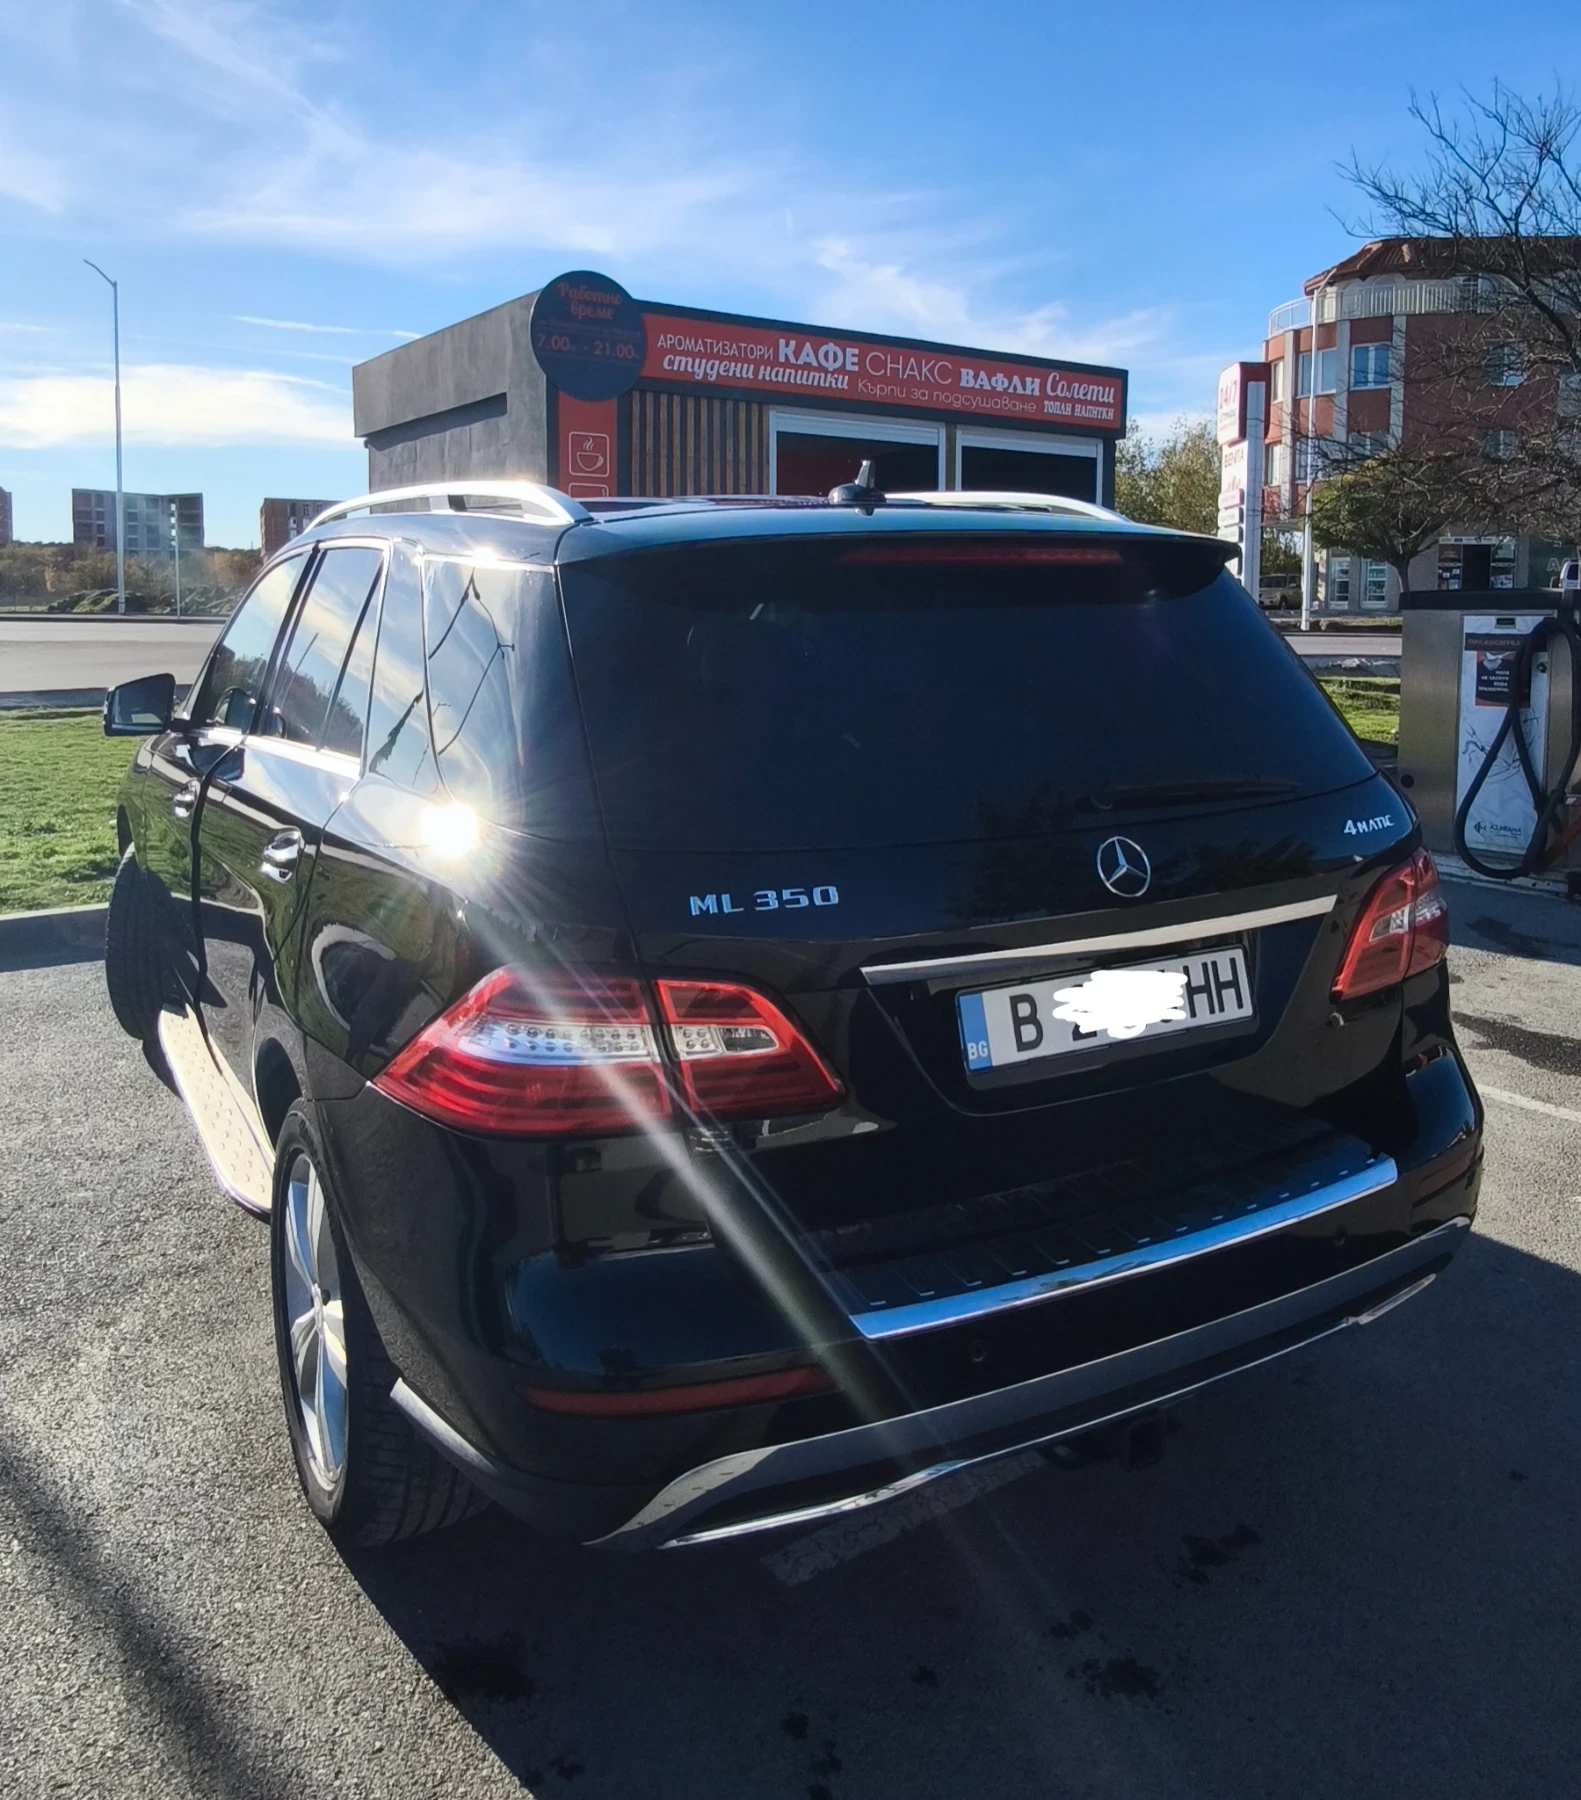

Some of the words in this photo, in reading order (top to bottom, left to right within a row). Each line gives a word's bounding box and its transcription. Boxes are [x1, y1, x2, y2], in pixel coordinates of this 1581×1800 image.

[657, 333, 774, 361] АРОМАТИЗАТОРИ
[778, 338, 859, 371] КАФЕ
[865, 351, 952, 385] СНАКС
[959, 367, 1041, 396] ВАФЛИ
[1046, 372, 1115, 403] Солети
[662, 354, 755, 381] студени
[758, 364, 849, 390] напитки
[857, 378, 906, 399] Кърпи
[910, 387, 929, 401] за
[932, 390, 1037, 413] подсушаване
[1043, 400, 1072, 415] ТОПЛИ
[1073, 403, 1115, 420] НАПИТКИ
[1343, 814, 1395, 835] 4MATIC
[689, 893, 744, 916] ML
[753, 883, 839, 911] 350
[1009, 993, 1044, 1053] B
[1182, 957, 1244, 1019] HH
[966, 1040, 989, 1061] BG
